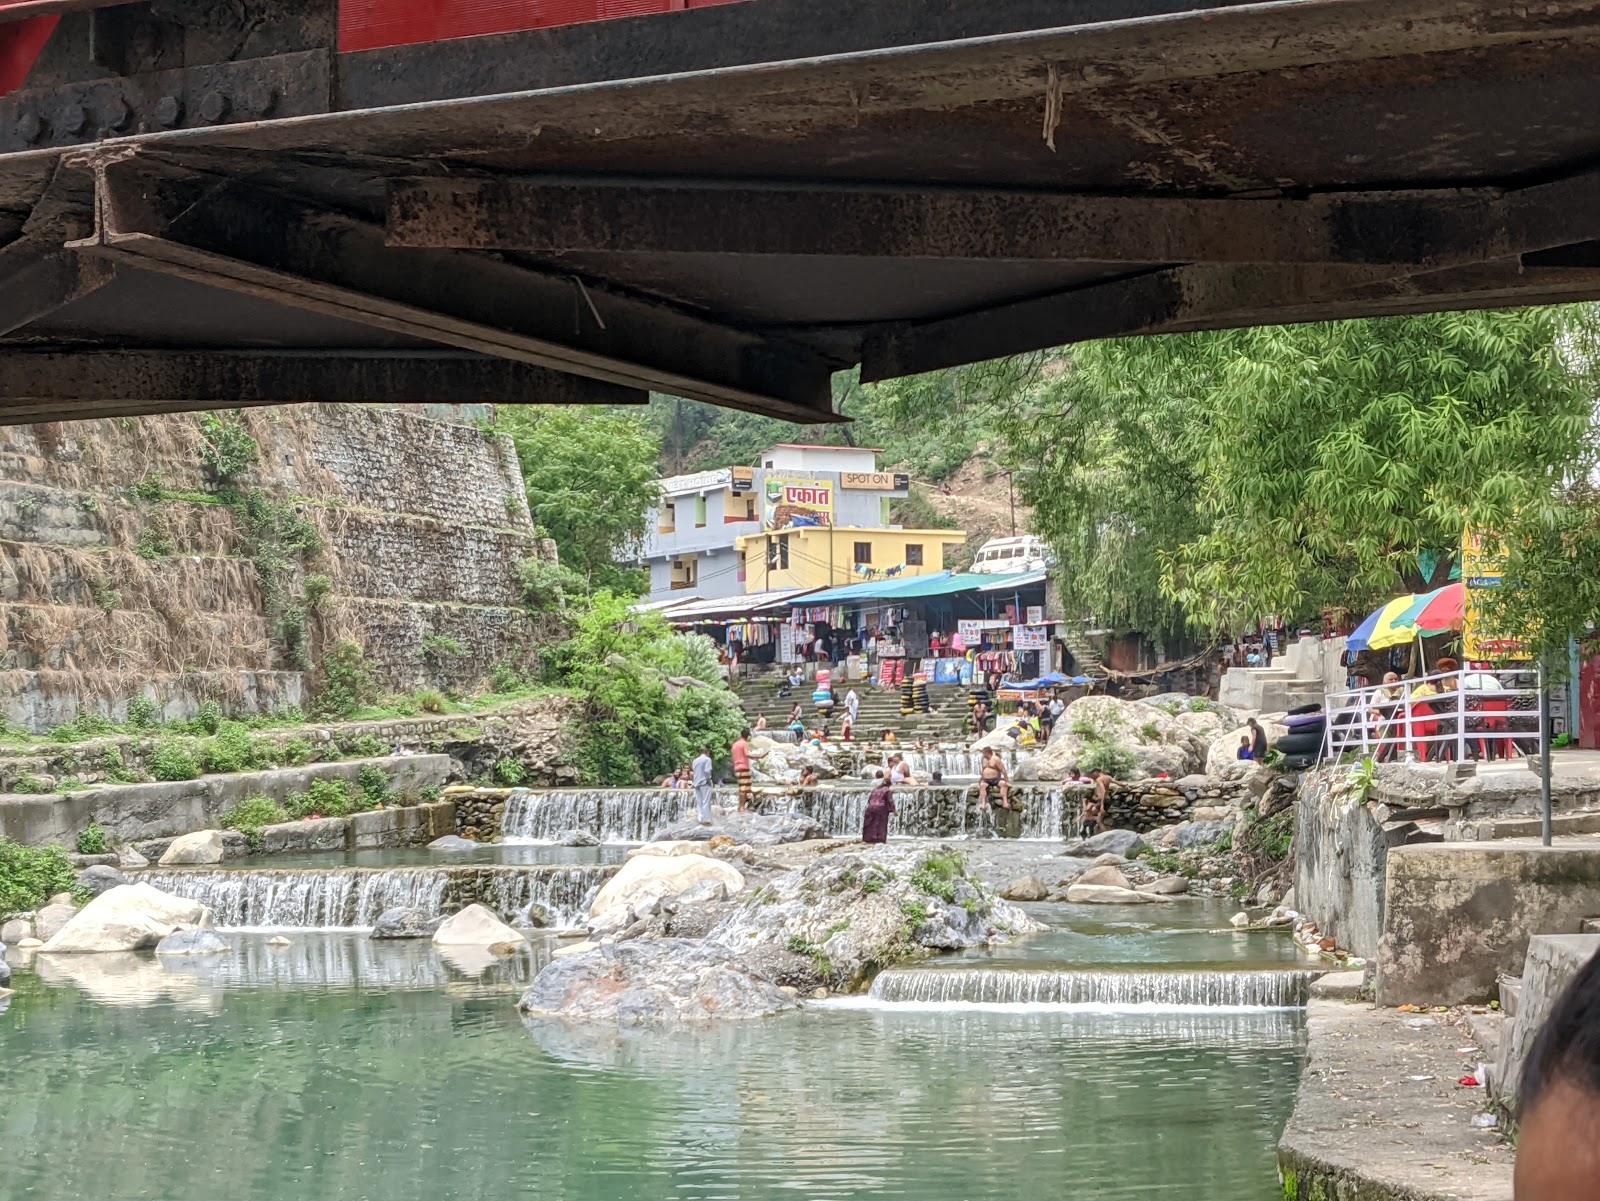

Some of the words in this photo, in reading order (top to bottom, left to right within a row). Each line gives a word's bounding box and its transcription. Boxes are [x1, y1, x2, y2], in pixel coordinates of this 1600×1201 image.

[688, 475, 717, 487] HOUSE
[847, 473, 871, 484] SPOT
[872, 474, 889, 484] ON
[785, 482, 830, 505] एकांत
